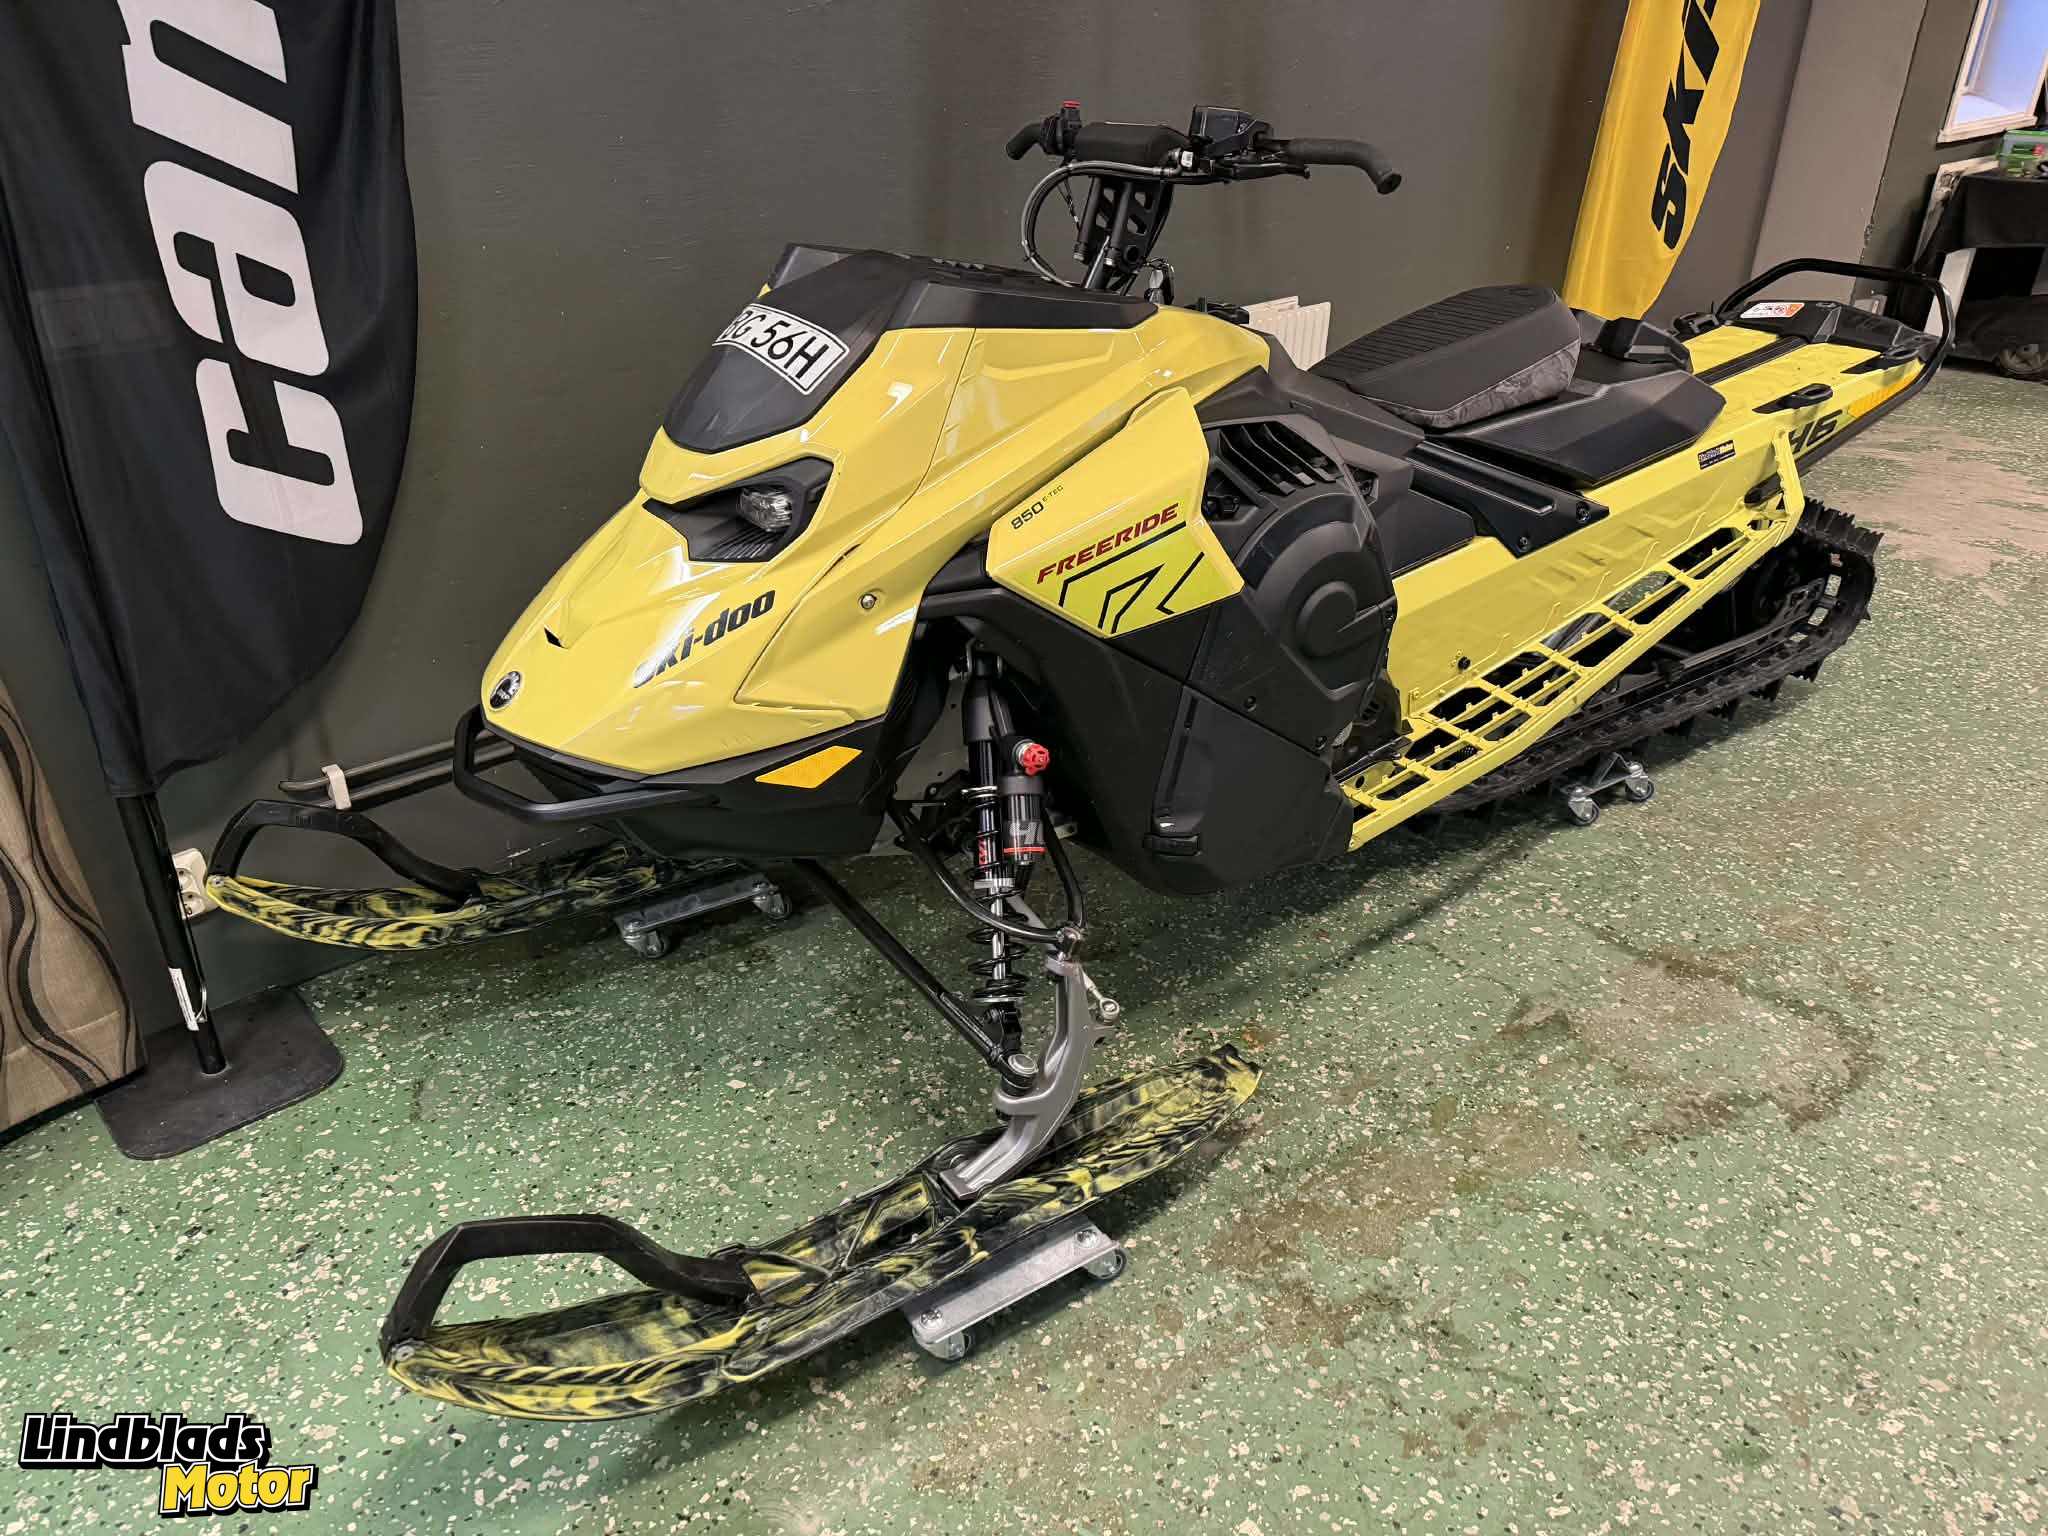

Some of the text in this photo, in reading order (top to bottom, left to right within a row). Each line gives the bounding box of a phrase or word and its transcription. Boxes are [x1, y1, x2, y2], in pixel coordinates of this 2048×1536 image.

[1651, 0, 1720, 250] SKI
[117, 0, 364, 545] can
[750, 320, 830, 379] 56H
[1011, 501, 1044, 530] 850
[1036, 503, 1179, 584] FREERIDE
